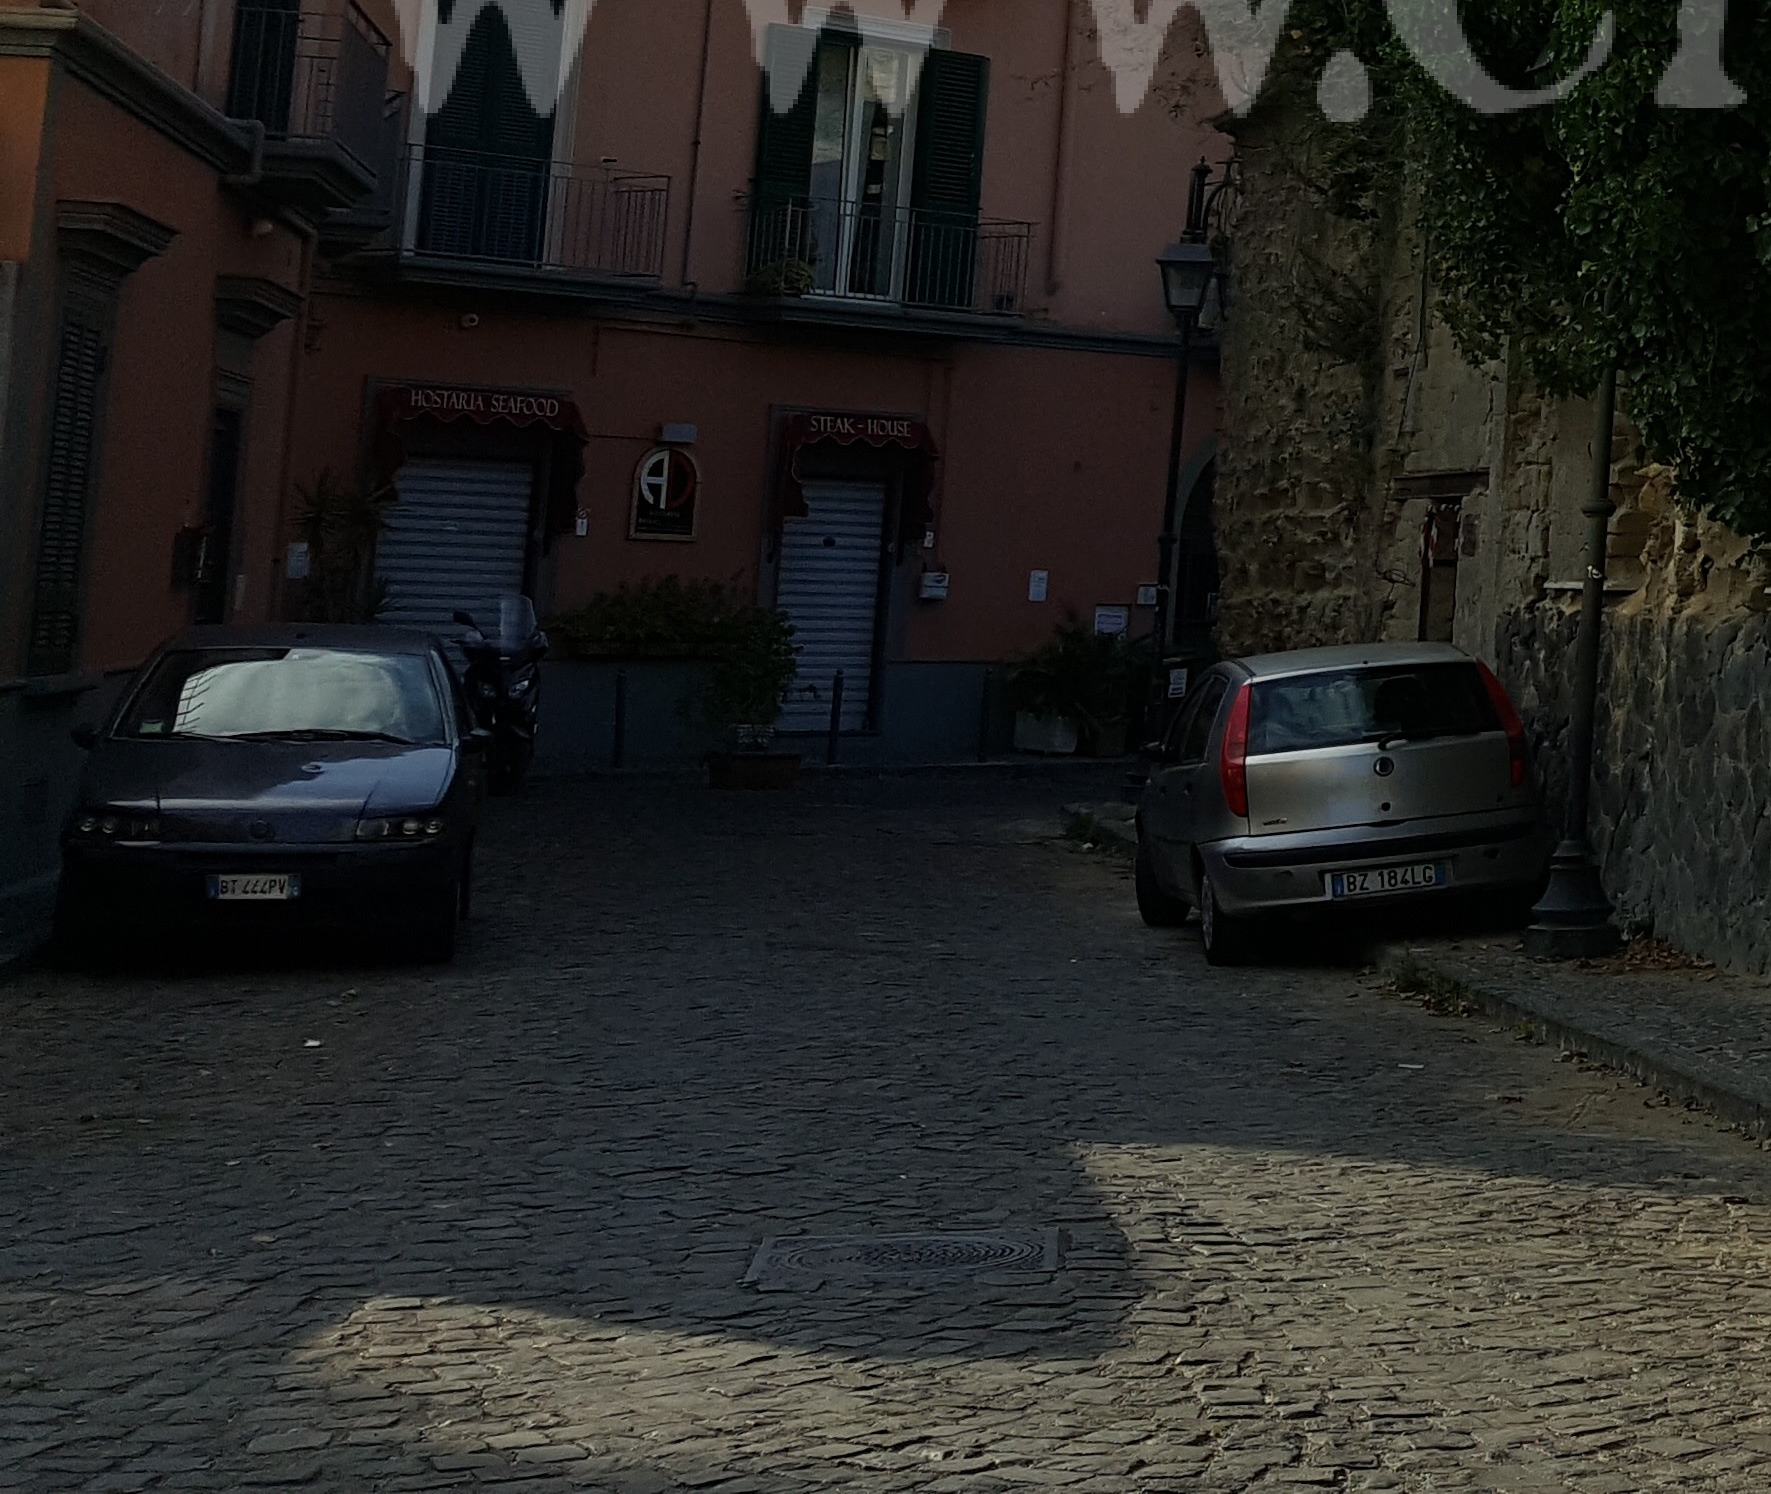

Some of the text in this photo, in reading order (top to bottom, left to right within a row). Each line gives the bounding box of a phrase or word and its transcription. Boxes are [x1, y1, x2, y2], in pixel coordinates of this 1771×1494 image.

[410, 390, 559, 416] HOSTARIA SEAFOOD
[810, 415, 855, 434] STEAK
[867, 419, 911, 437] HOUSE
[1347, 866, 1433, 892] BZ 184LG
